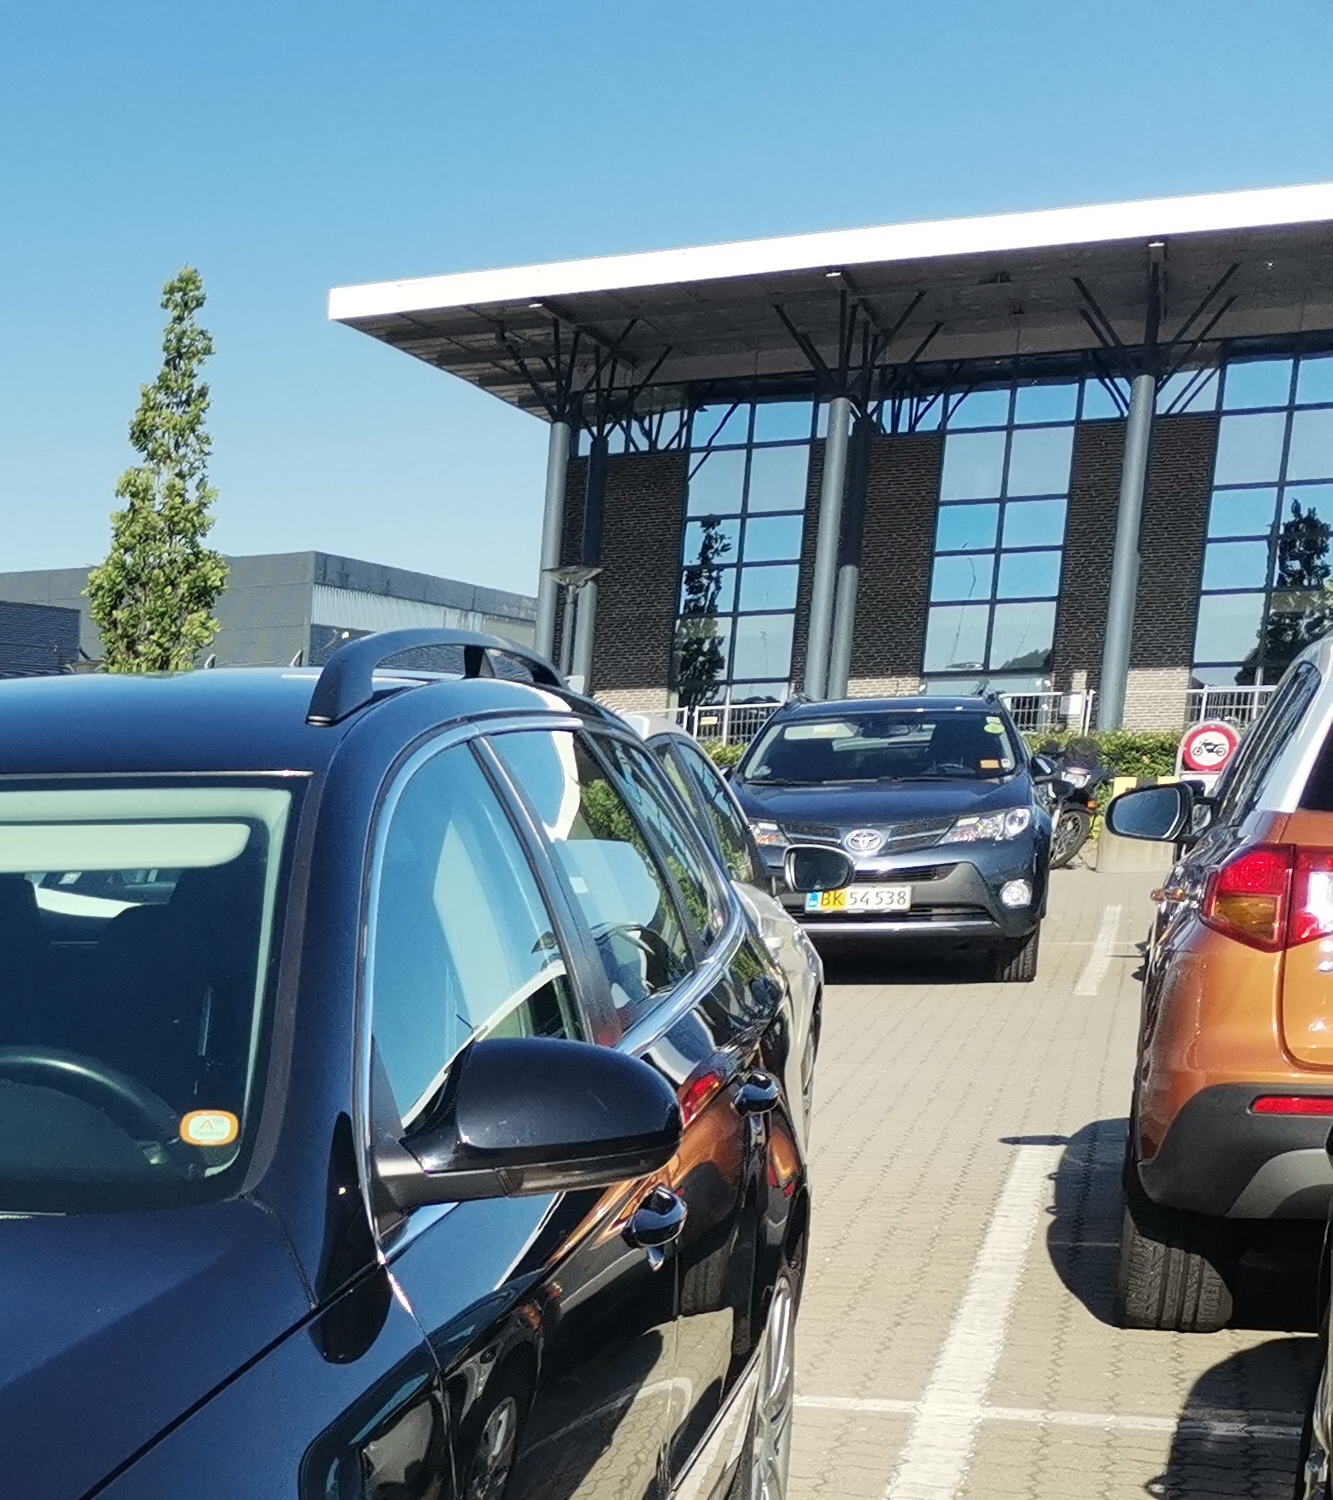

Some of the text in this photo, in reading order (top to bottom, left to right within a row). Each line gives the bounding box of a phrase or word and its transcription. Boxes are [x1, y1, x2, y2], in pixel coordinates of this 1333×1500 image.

[820, 891, 845, 906] BK
[848, 891, 870, 906] 54
[874, 890, 907, 906] 538
